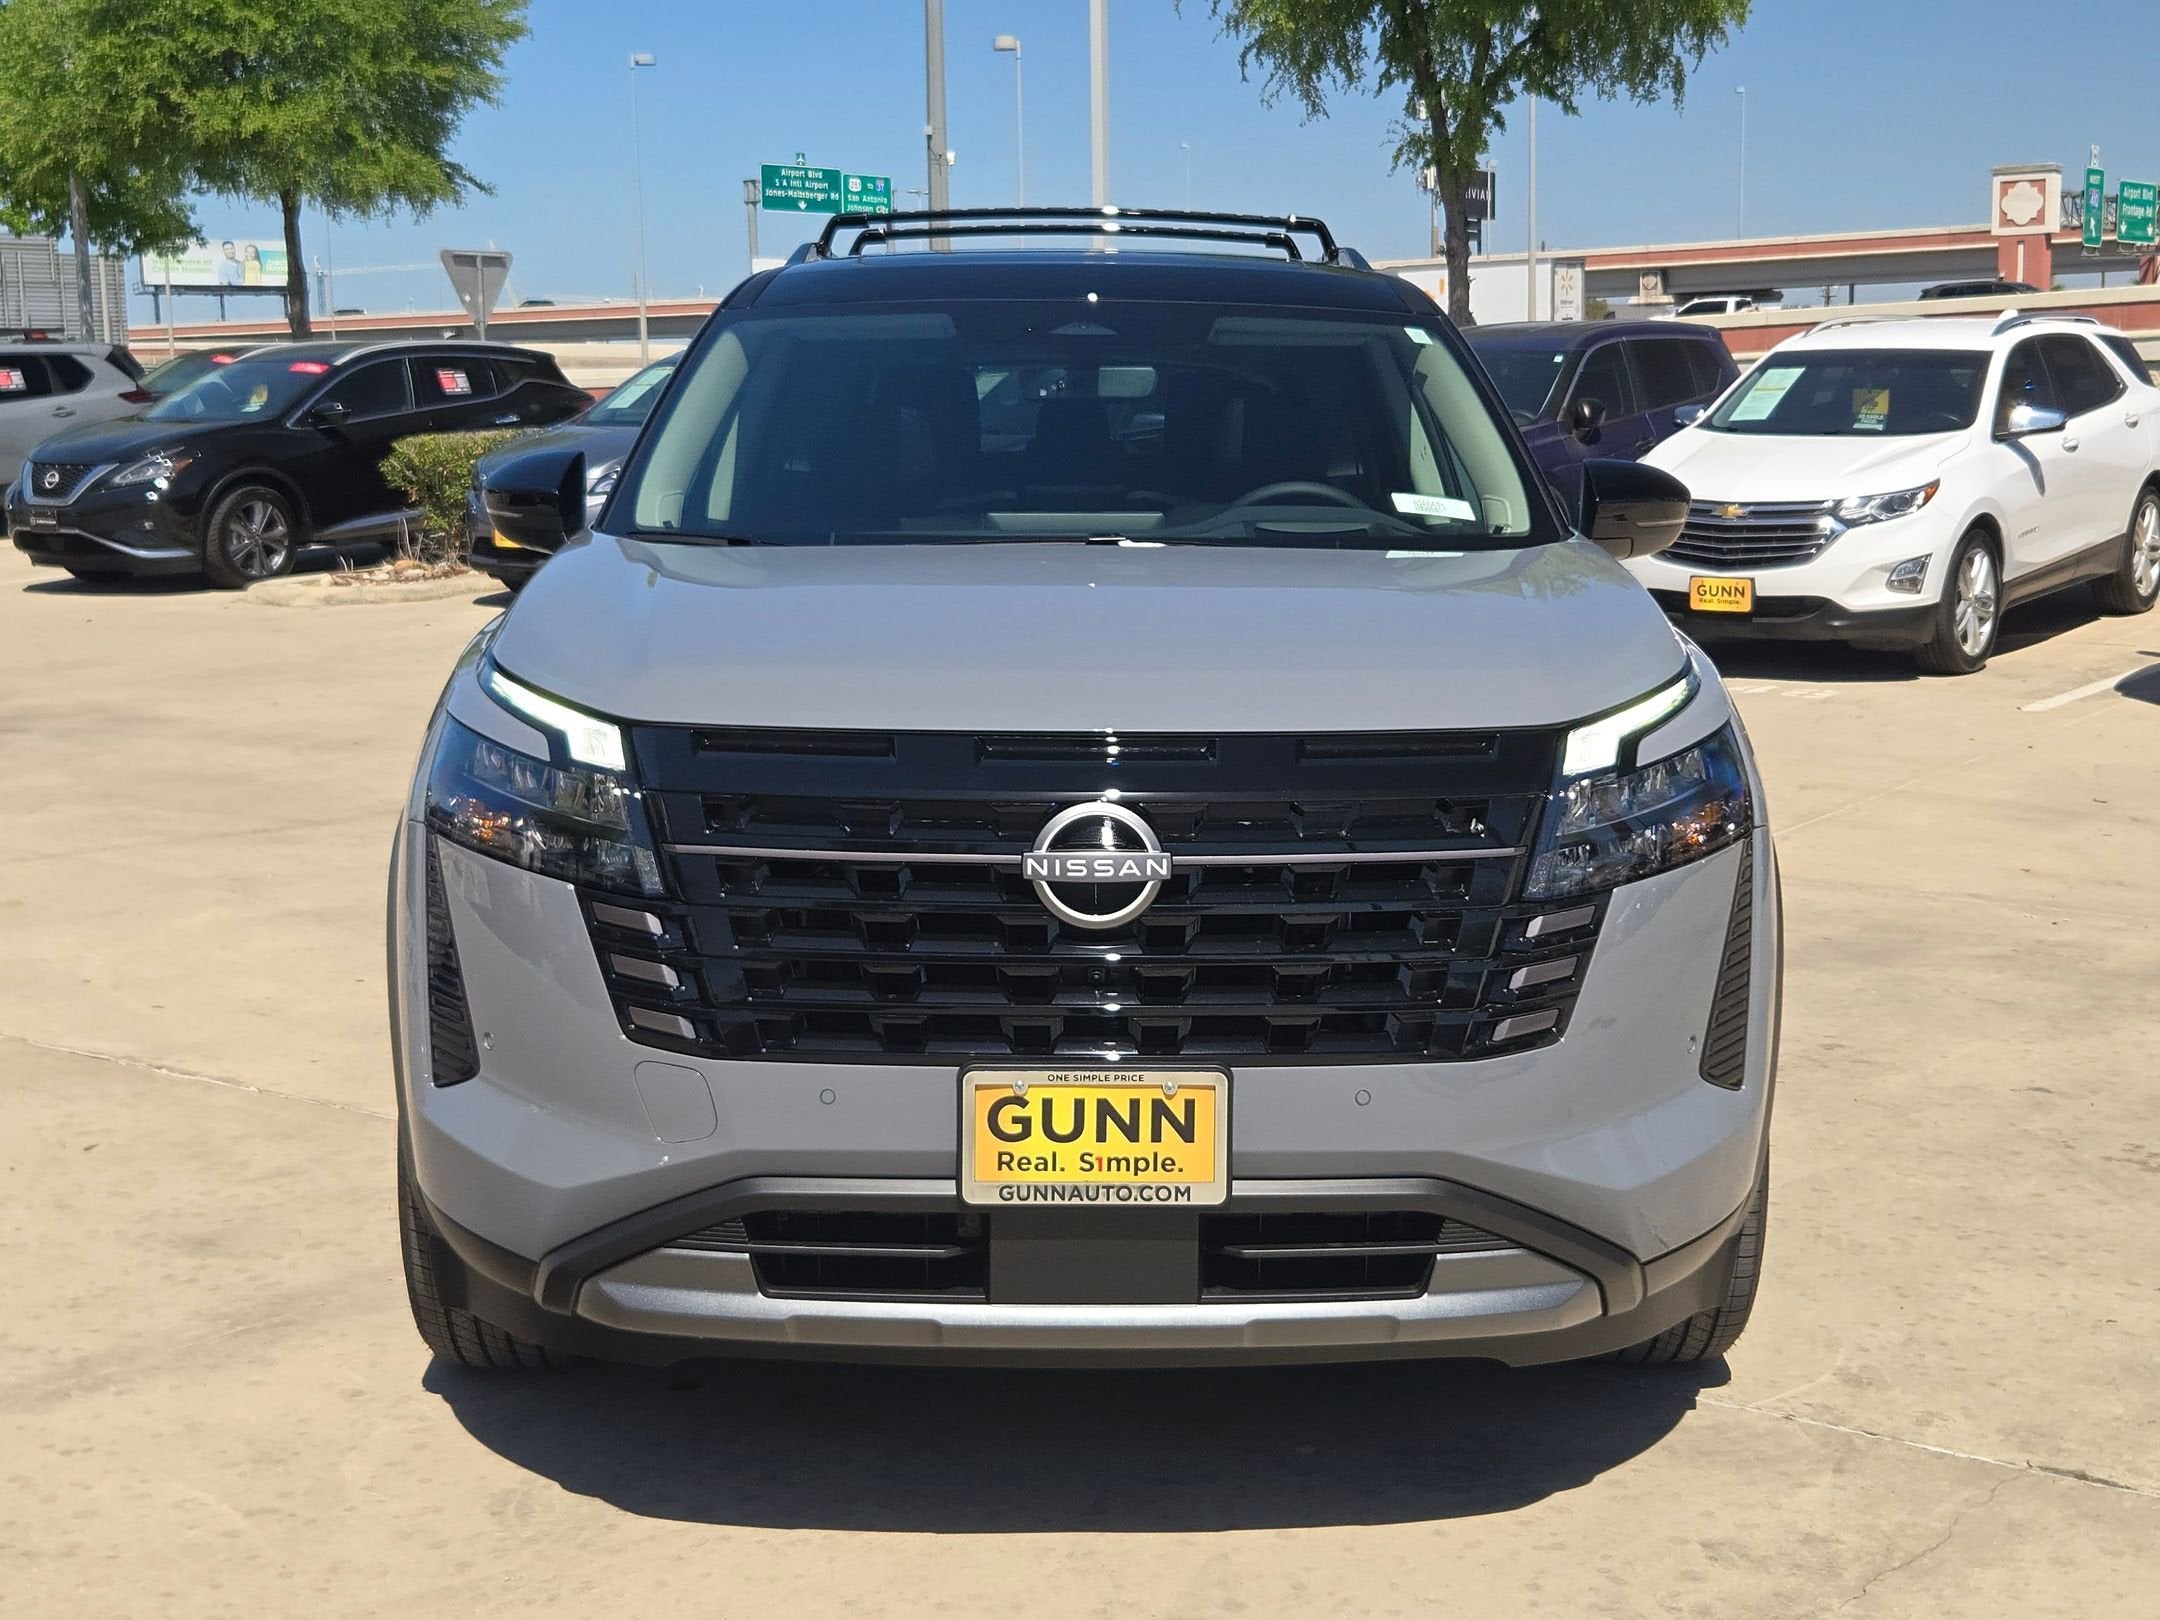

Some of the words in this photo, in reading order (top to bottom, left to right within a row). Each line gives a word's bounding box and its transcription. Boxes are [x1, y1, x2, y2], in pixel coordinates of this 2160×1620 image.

[781, 168, 805, 178] Airport
[807, 170, 823, 178] Blvd
[775, 179, 780, 187] S
[782, 179, 788, 187] A
[805, 180, 829, 190] Airport
[1697, 584, 1745, 598] GUNN
[1026, 857, 1168, 877] NISSAN
[1047, 1073, 1070, 1082] ONE
[1073, 1073, 1111, 1082] SIMPLE
[1114, 1073, 1145, 1082] PRICE
[987, 1095, 1196, 1144] GUNN
[997, 1151, 1066, 1172] Real.
[999, 1185, 1191, 1202] GUNNAUTO.COM
